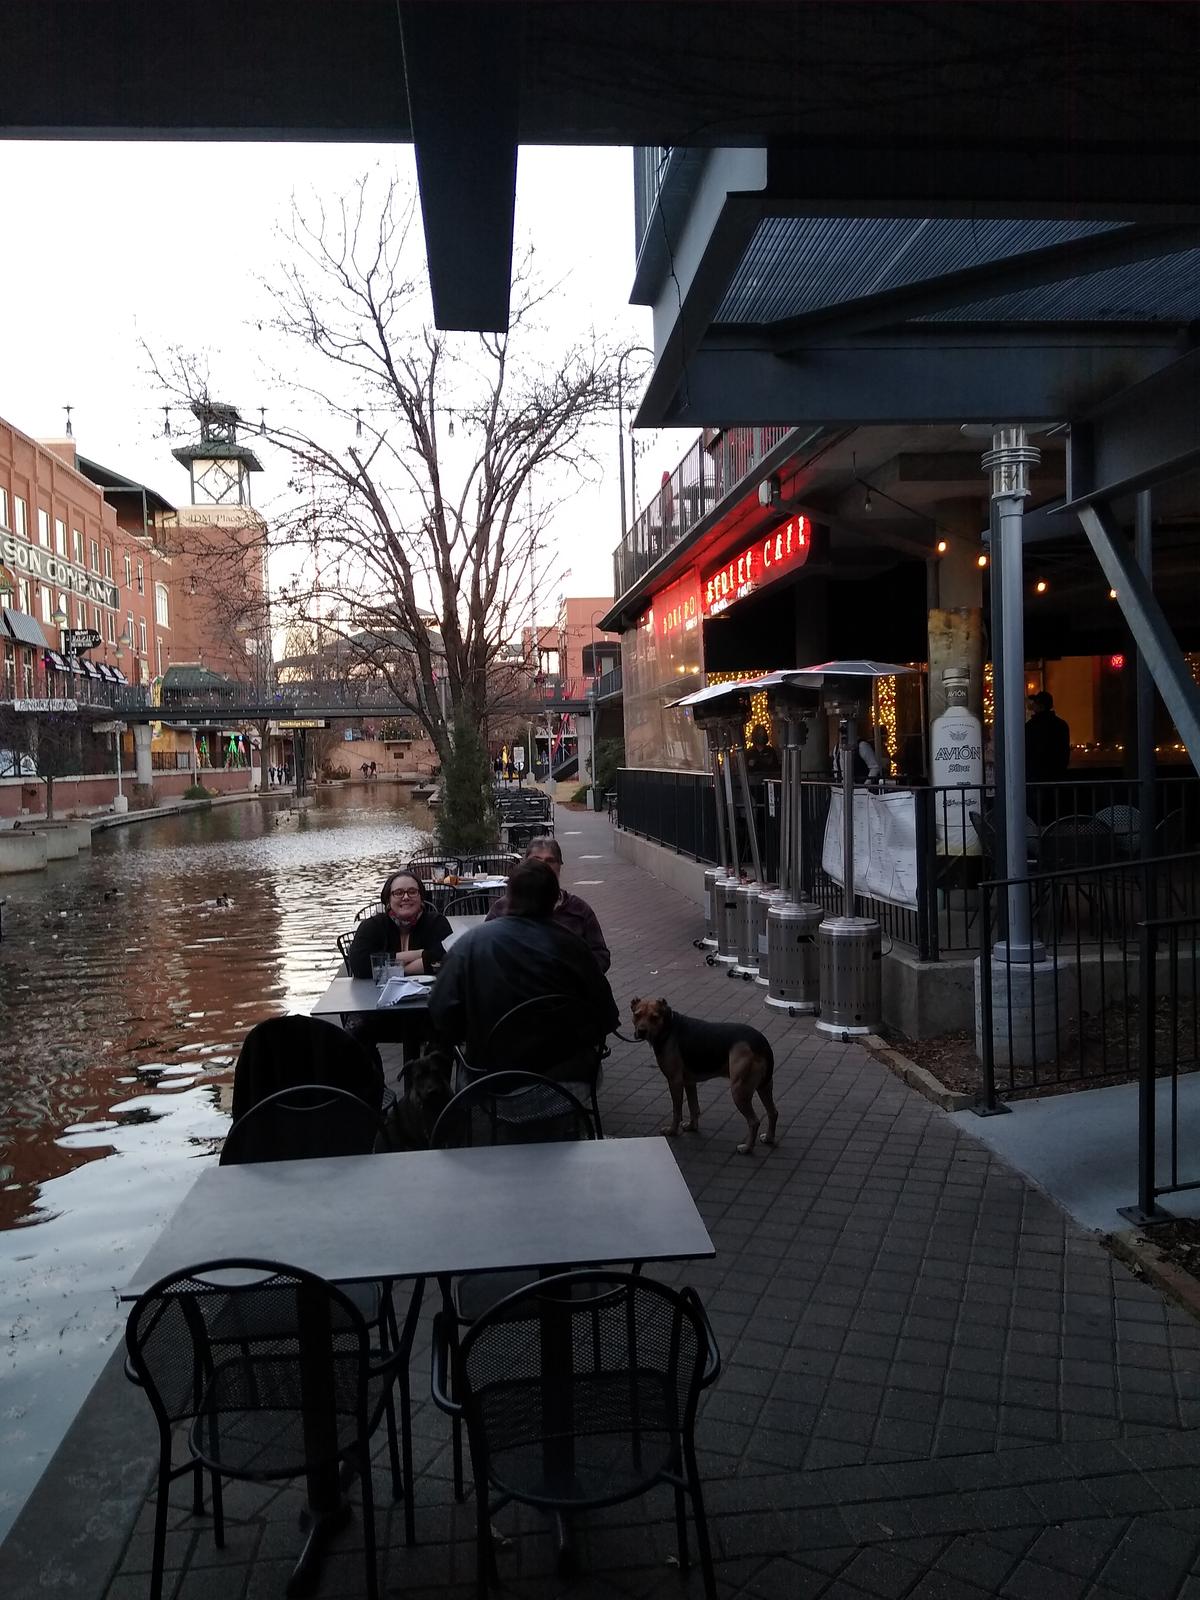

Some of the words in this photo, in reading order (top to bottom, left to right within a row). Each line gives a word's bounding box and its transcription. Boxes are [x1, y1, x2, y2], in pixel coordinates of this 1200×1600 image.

[764, 516, 805, 567] CAFE
[47, 559, 113, 605] COMPANY
[935, 744, 981, 760] AVIÓN
